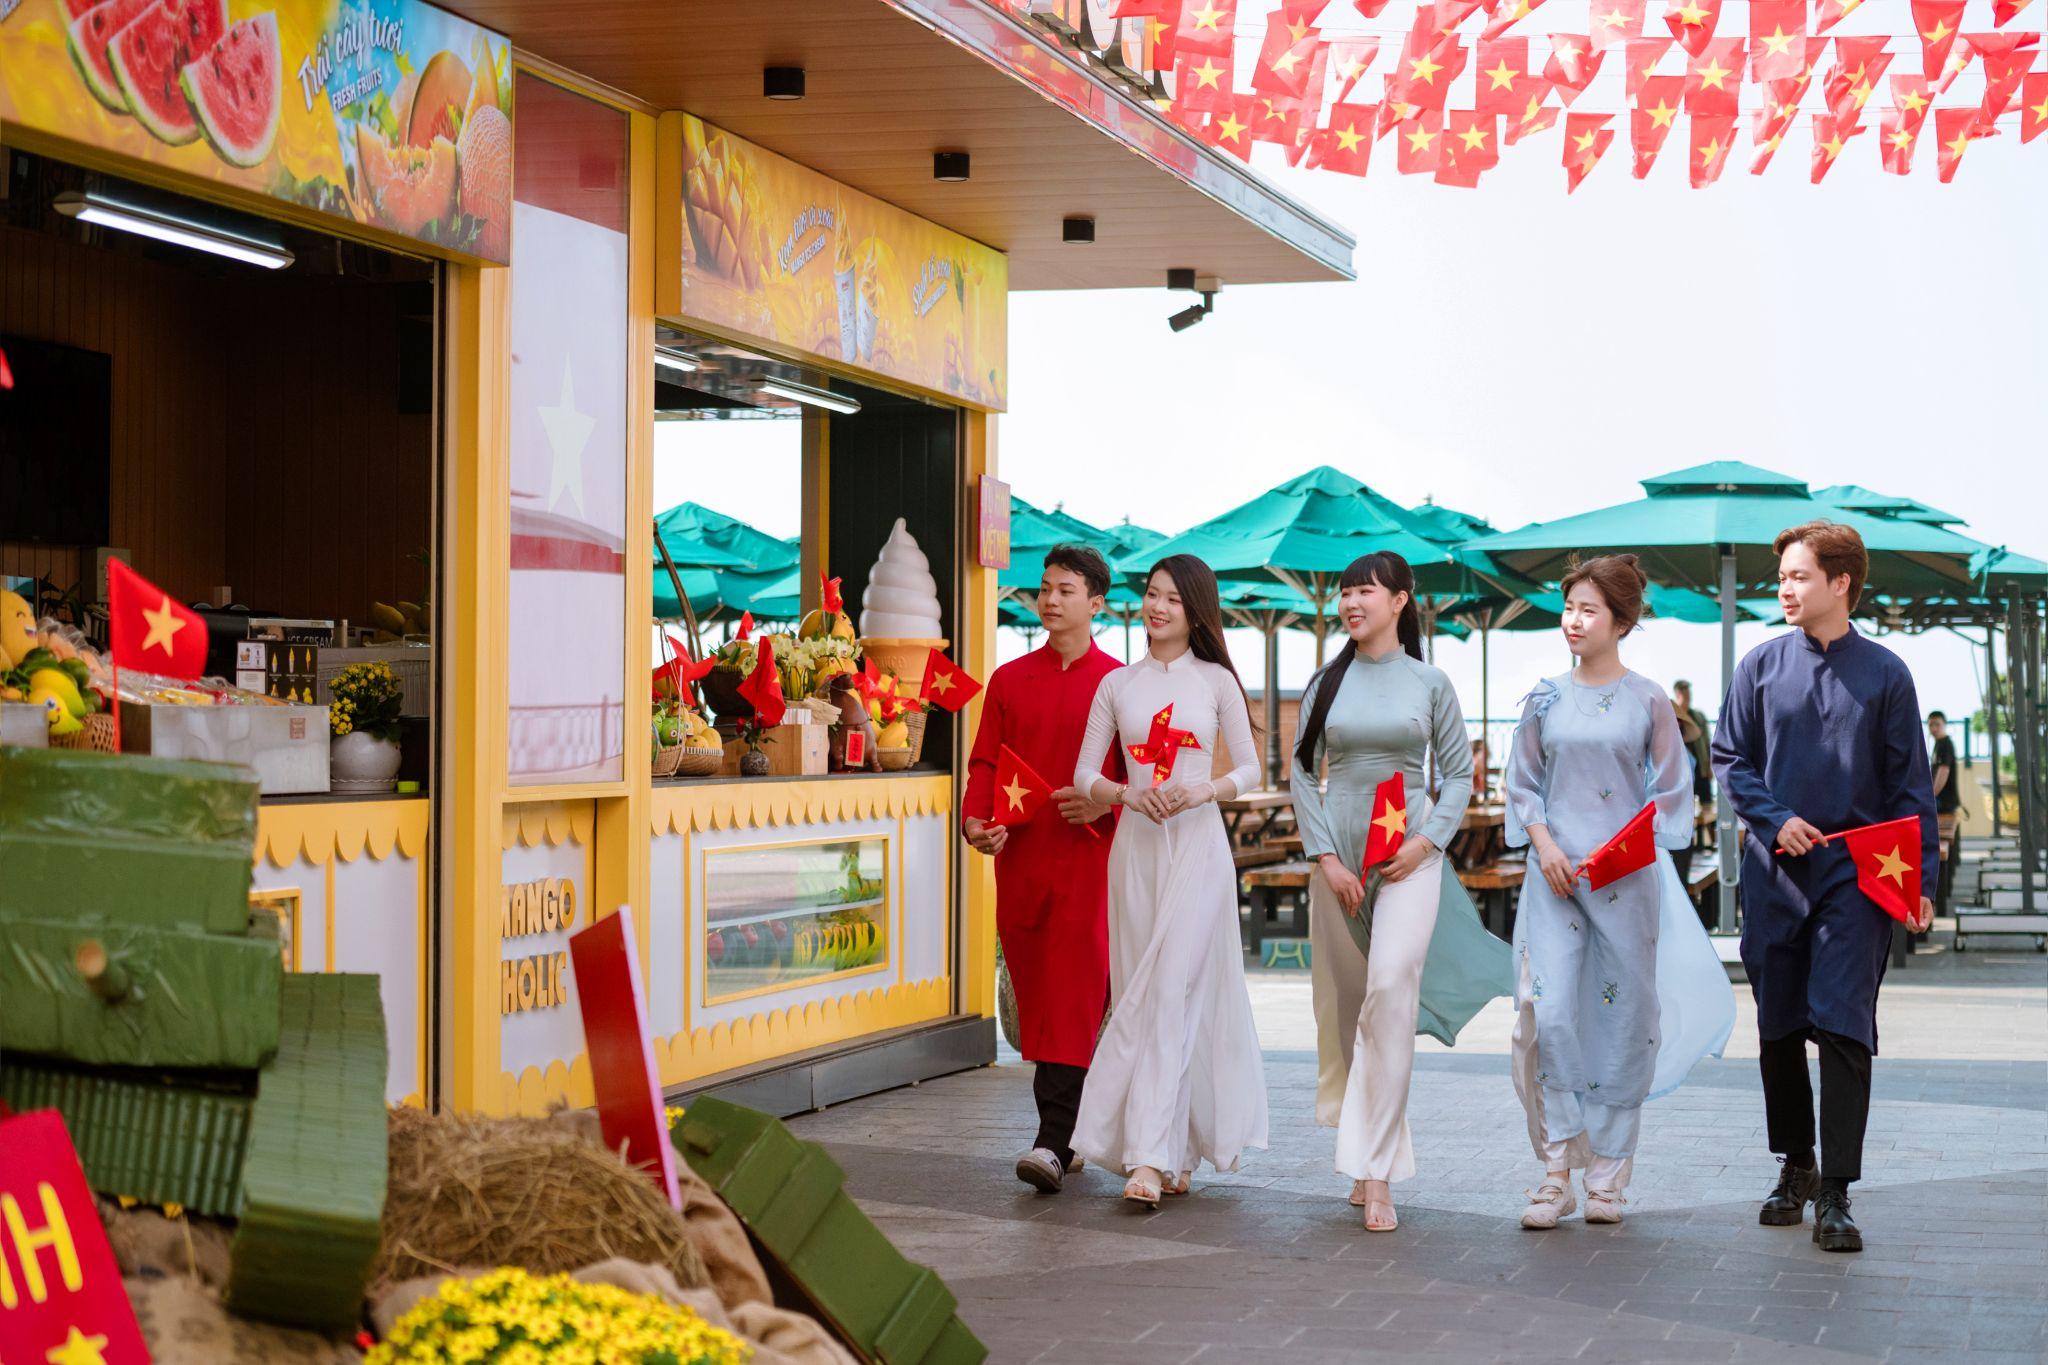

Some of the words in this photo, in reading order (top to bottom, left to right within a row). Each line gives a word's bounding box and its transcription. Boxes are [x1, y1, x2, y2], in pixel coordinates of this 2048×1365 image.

[297, 34, 334, 113] Trái
[335, 15, 366, 72] cây
[368, 8, 404, 56] tươi
[332, 82, 358, 112] FRESH
[356, 67, 383, 97] FRUITS
[501, 951, 567, 1014] HOLIC
